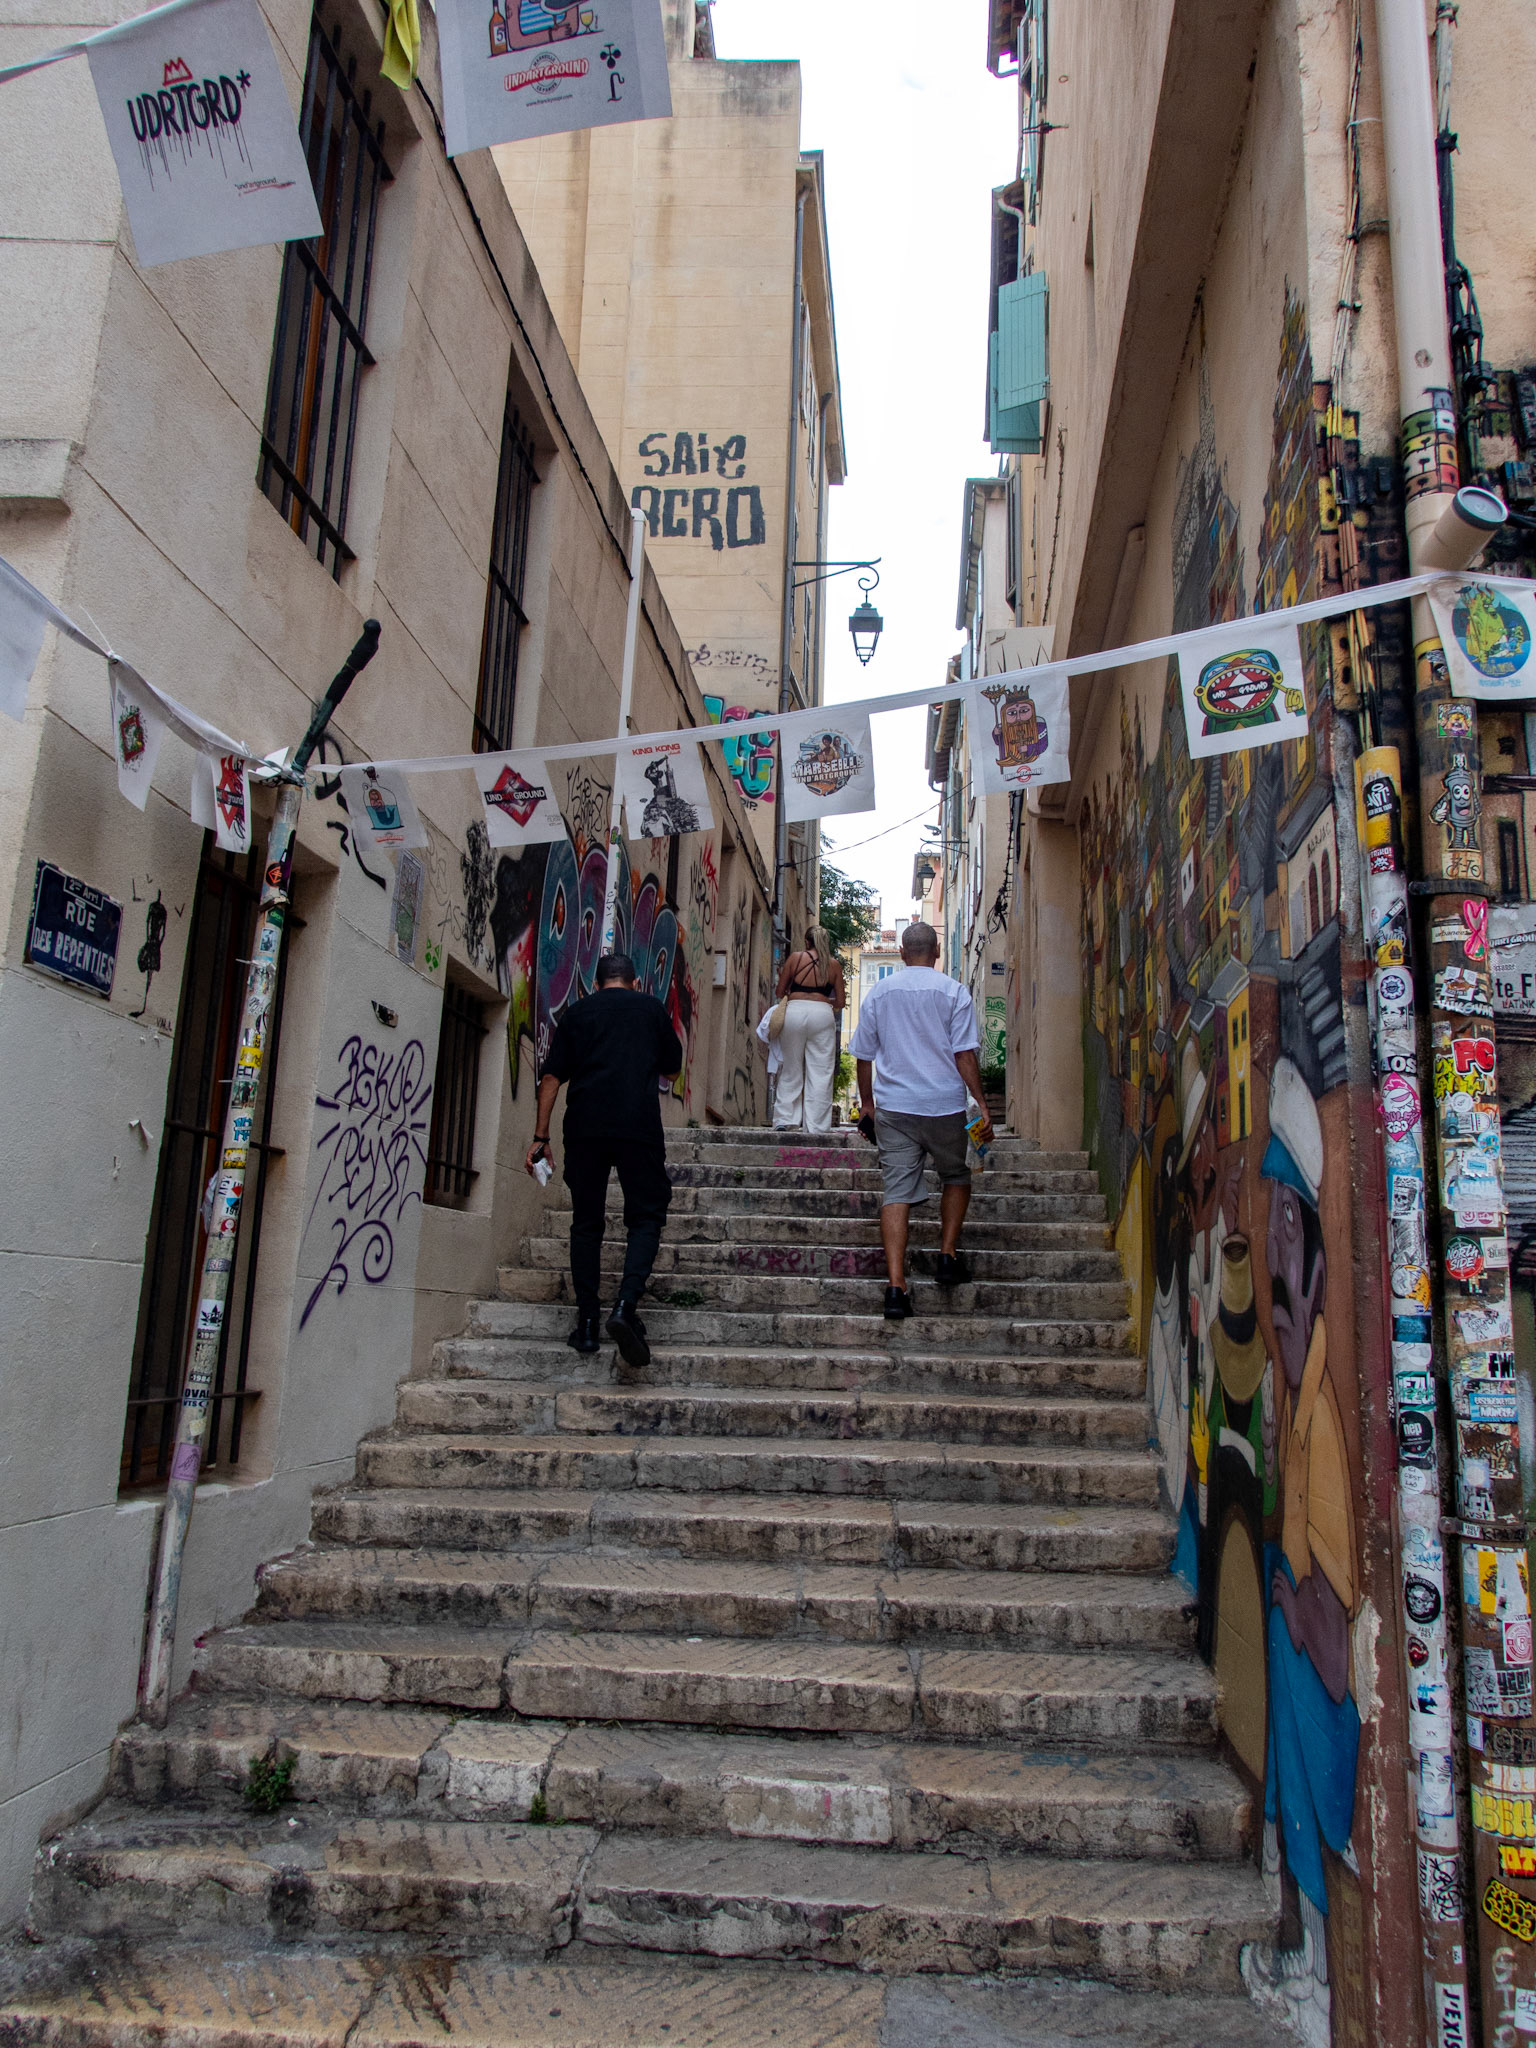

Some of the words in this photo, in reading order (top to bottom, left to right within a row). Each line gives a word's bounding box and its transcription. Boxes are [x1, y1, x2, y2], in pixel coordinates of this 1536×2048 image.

[631, 746, 653, 756] KING
[655, 743, 681, 753] KONG
[65, 900, 97, 932] RUE
